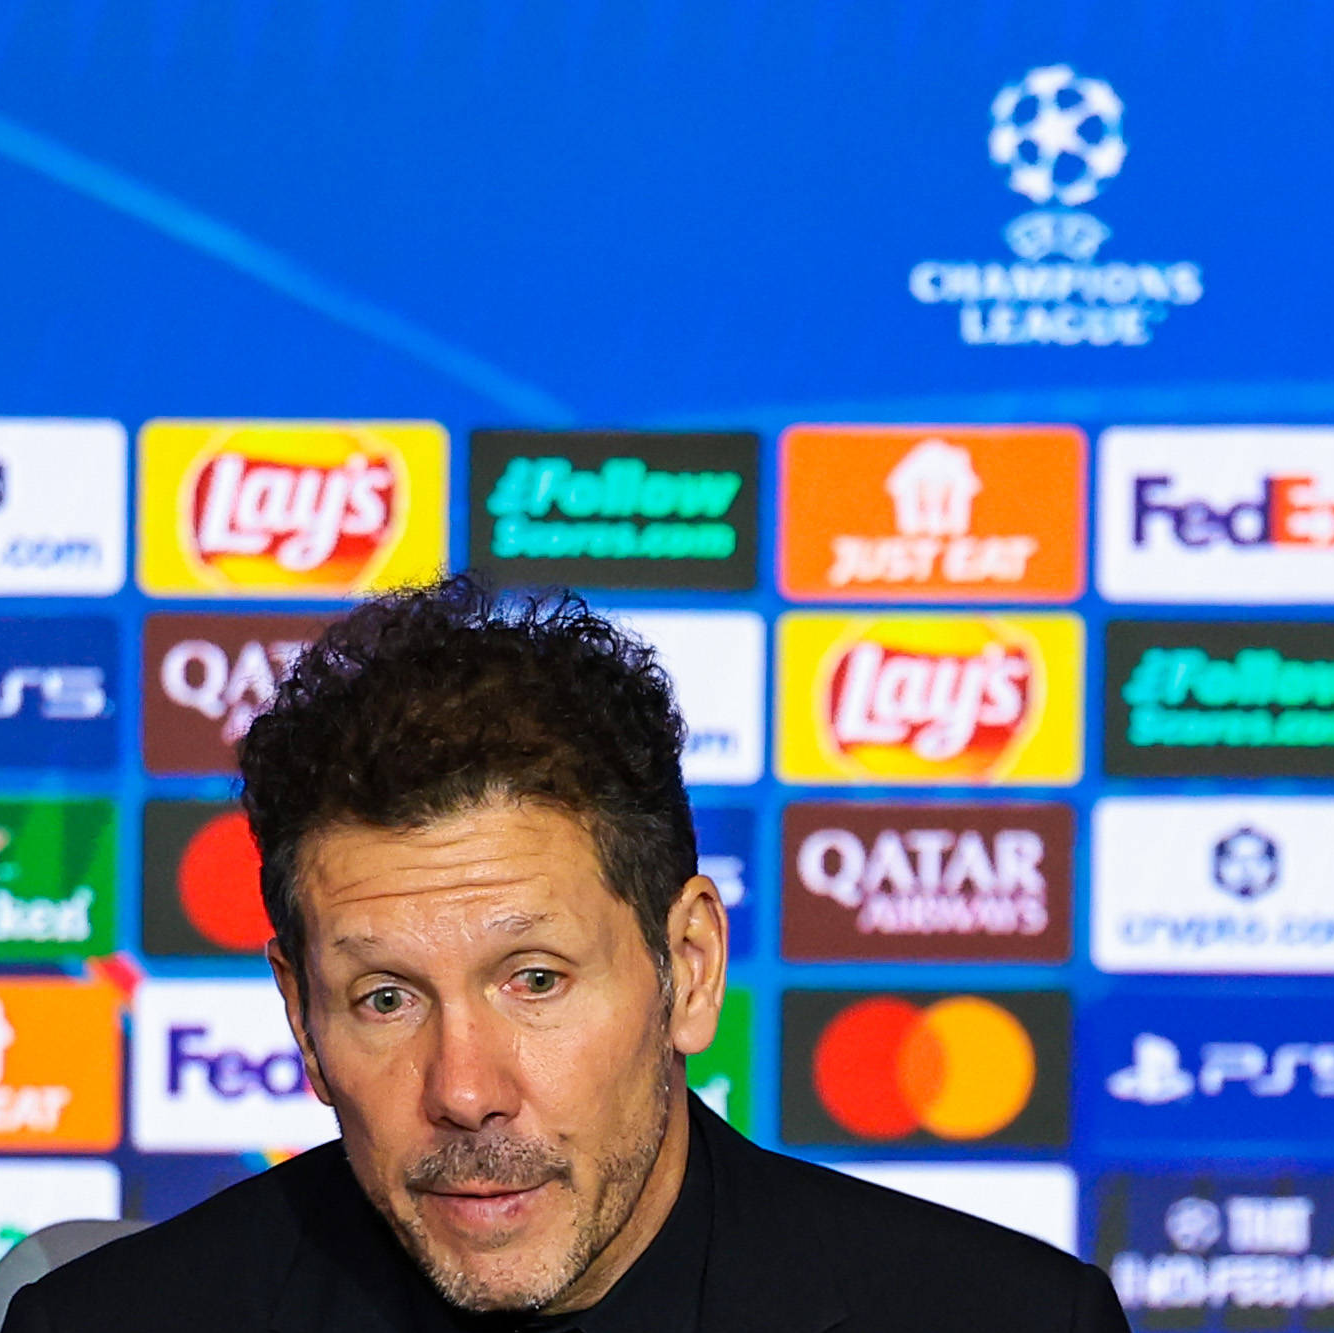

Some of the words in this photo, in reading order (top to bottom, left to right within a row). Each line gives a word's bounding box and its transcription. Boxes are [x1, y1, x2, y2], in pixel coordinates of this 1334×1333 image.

[909, 262, 1203, 304] CHAMPIONS
[198, 453, 392, 570] Lay's
[827, 536, 943, 587] JUST
[944, 536, 1038, 582] EAT
[833, 643, 1027, 759] Lay's
[798, 831, 1044, 908] QATAR
[168, 1026, 304, 1096] Fed
